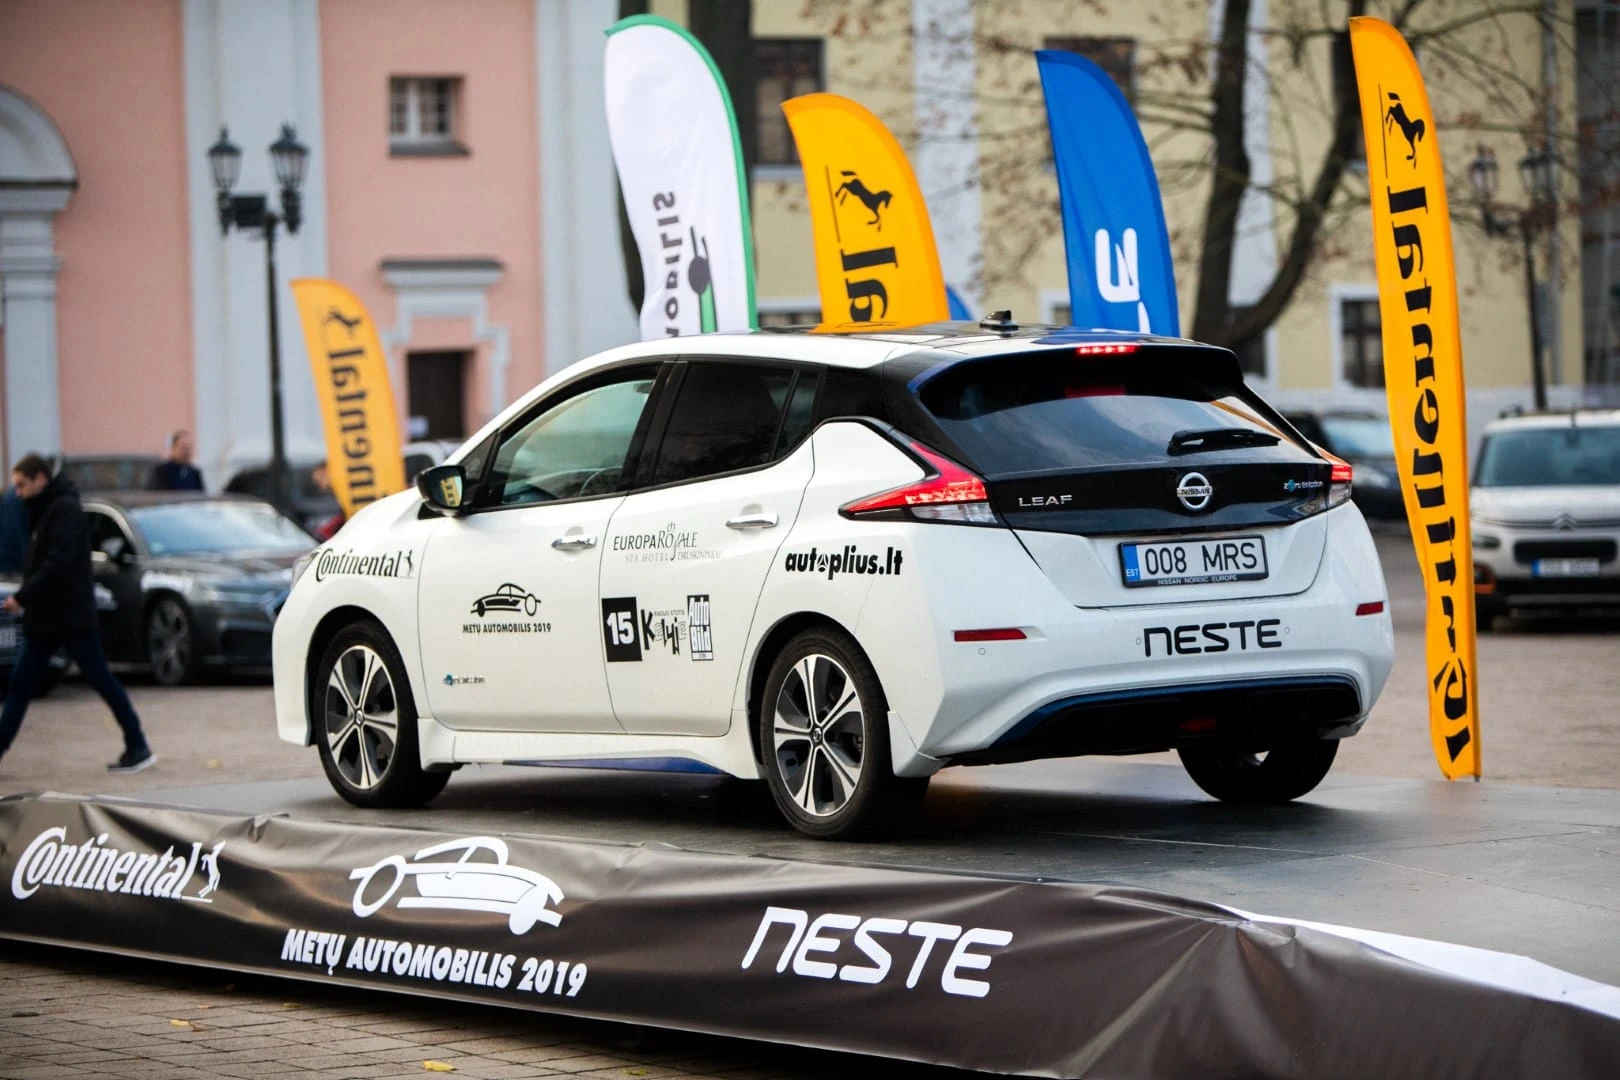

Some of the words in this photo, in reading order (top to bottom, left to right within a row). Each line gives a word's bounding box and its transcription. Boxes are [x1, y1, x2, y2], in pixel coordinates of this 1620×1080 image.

[1018, 494, 1073, 507] LEAF
[316, 548, 402, 582] Continental
[785, 545, 903, 580] autoplius.lt
[1126, 568, 1139, 577] EST
[1145, 546, 1187, 575] 008
[1201, 542, 1258, 572] MRS
[1158, 578, 1181, 586] NISSAN
[1184, 576, 1209, 584] NORDIC
[1212, 574, 1237, 582] EUROPE
[483, 623, 531, 633] AUTOMOBILIS
[534, 622, 551, 632] 2019
[607, 611, 635, 645] 15
[1144, 618, 1282, 657] NESTE
[11, 826, 203, 900] Continental
[281, 928, 346, 976] METŲ
[346, 936, 517, 989] AUTOMOBILIS
[517, 957, 587, 997] 2019
[741, 906, 1013, 997] NESTE
